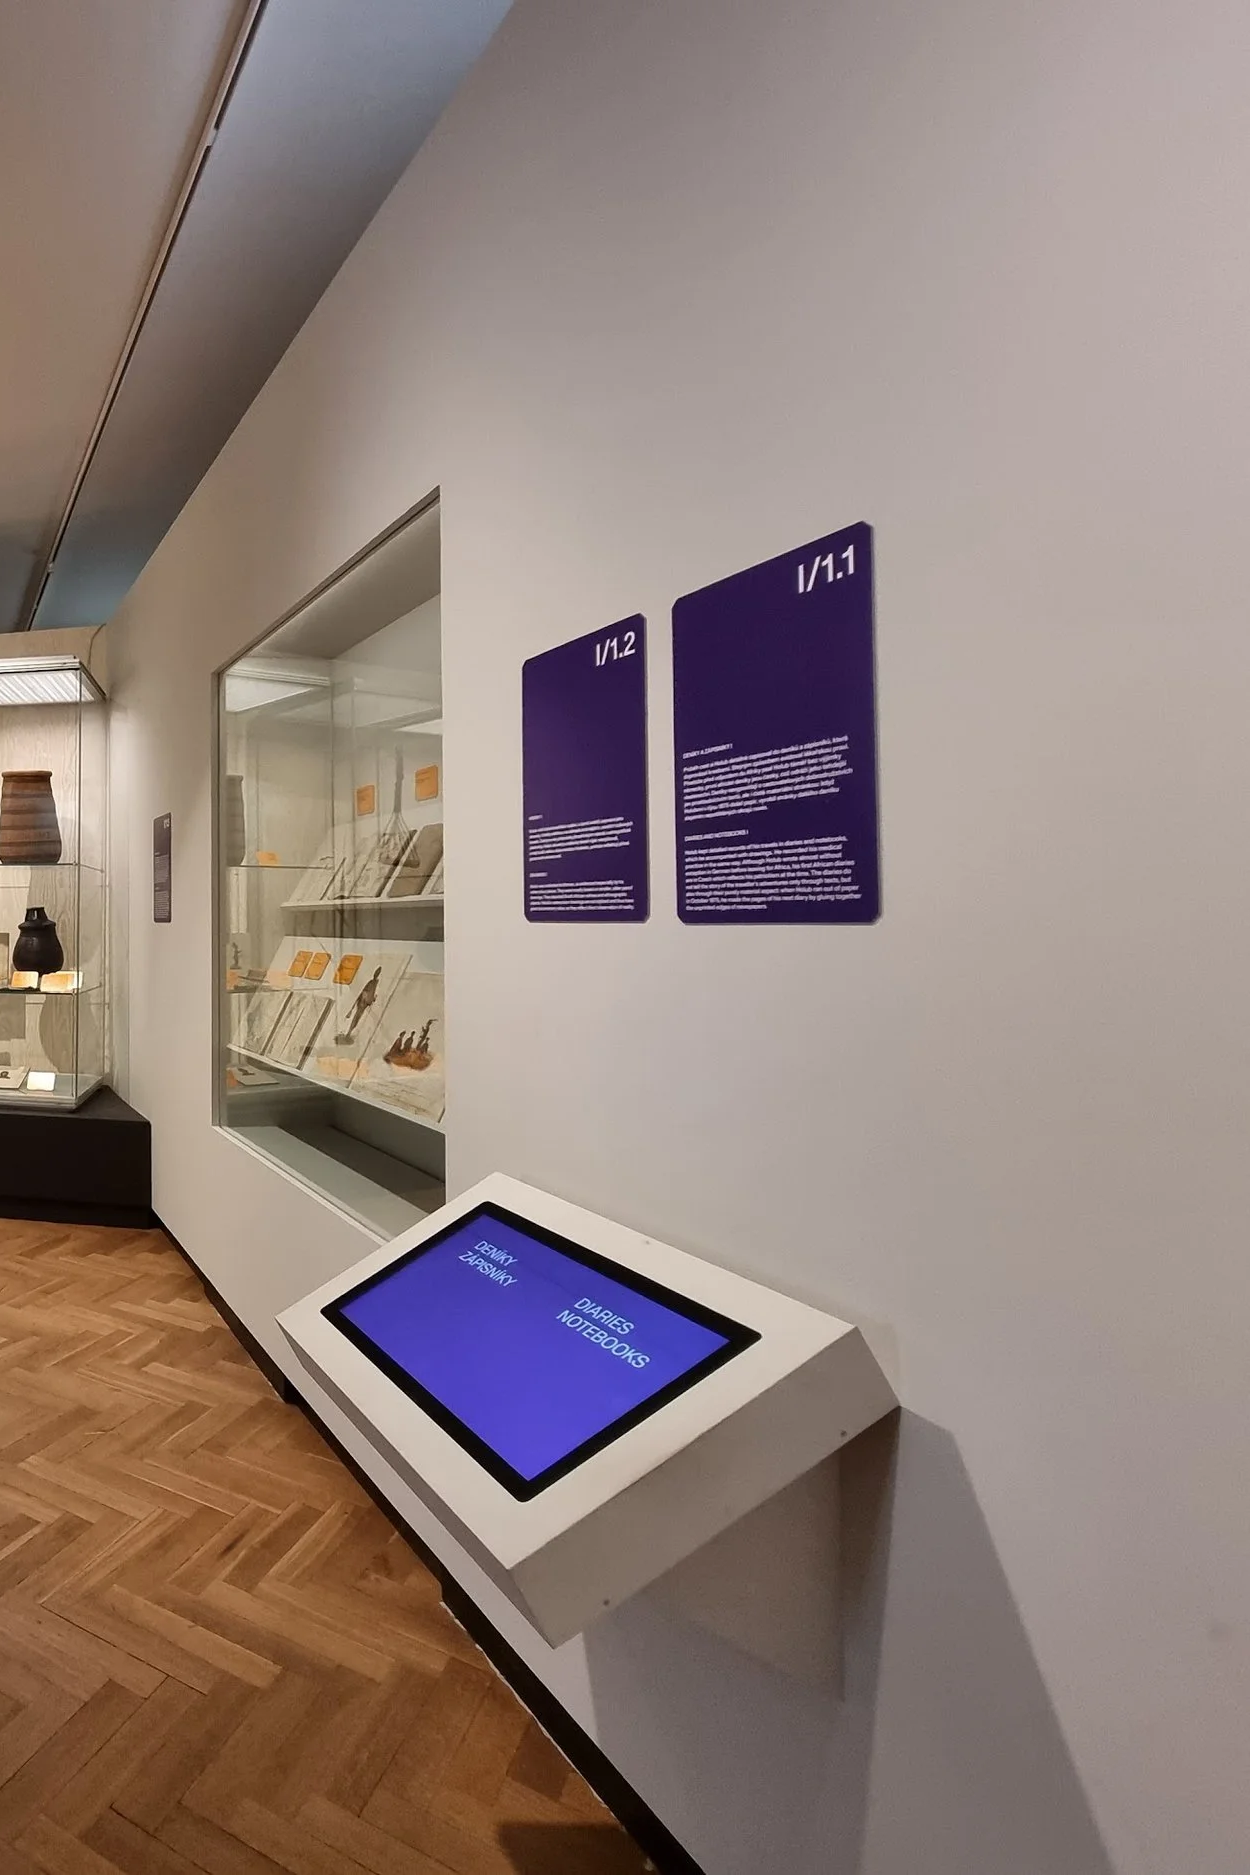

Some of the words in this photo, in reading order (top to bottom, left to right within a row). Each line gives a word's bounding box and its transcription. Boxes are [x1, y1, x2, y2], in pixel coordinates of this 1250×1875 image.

[797, 544, 855, 594] I/1.1
[595, 631, 636, 666] I/1.2
[458, 1250, 518, 1288] ZÁPISNÍKY
[473, 1240, 518, 1266] DENÍKY
[573, 1297, 635, 1336] DIARIES
[556, 1309, 651, 1370] NOTEBOOKS
